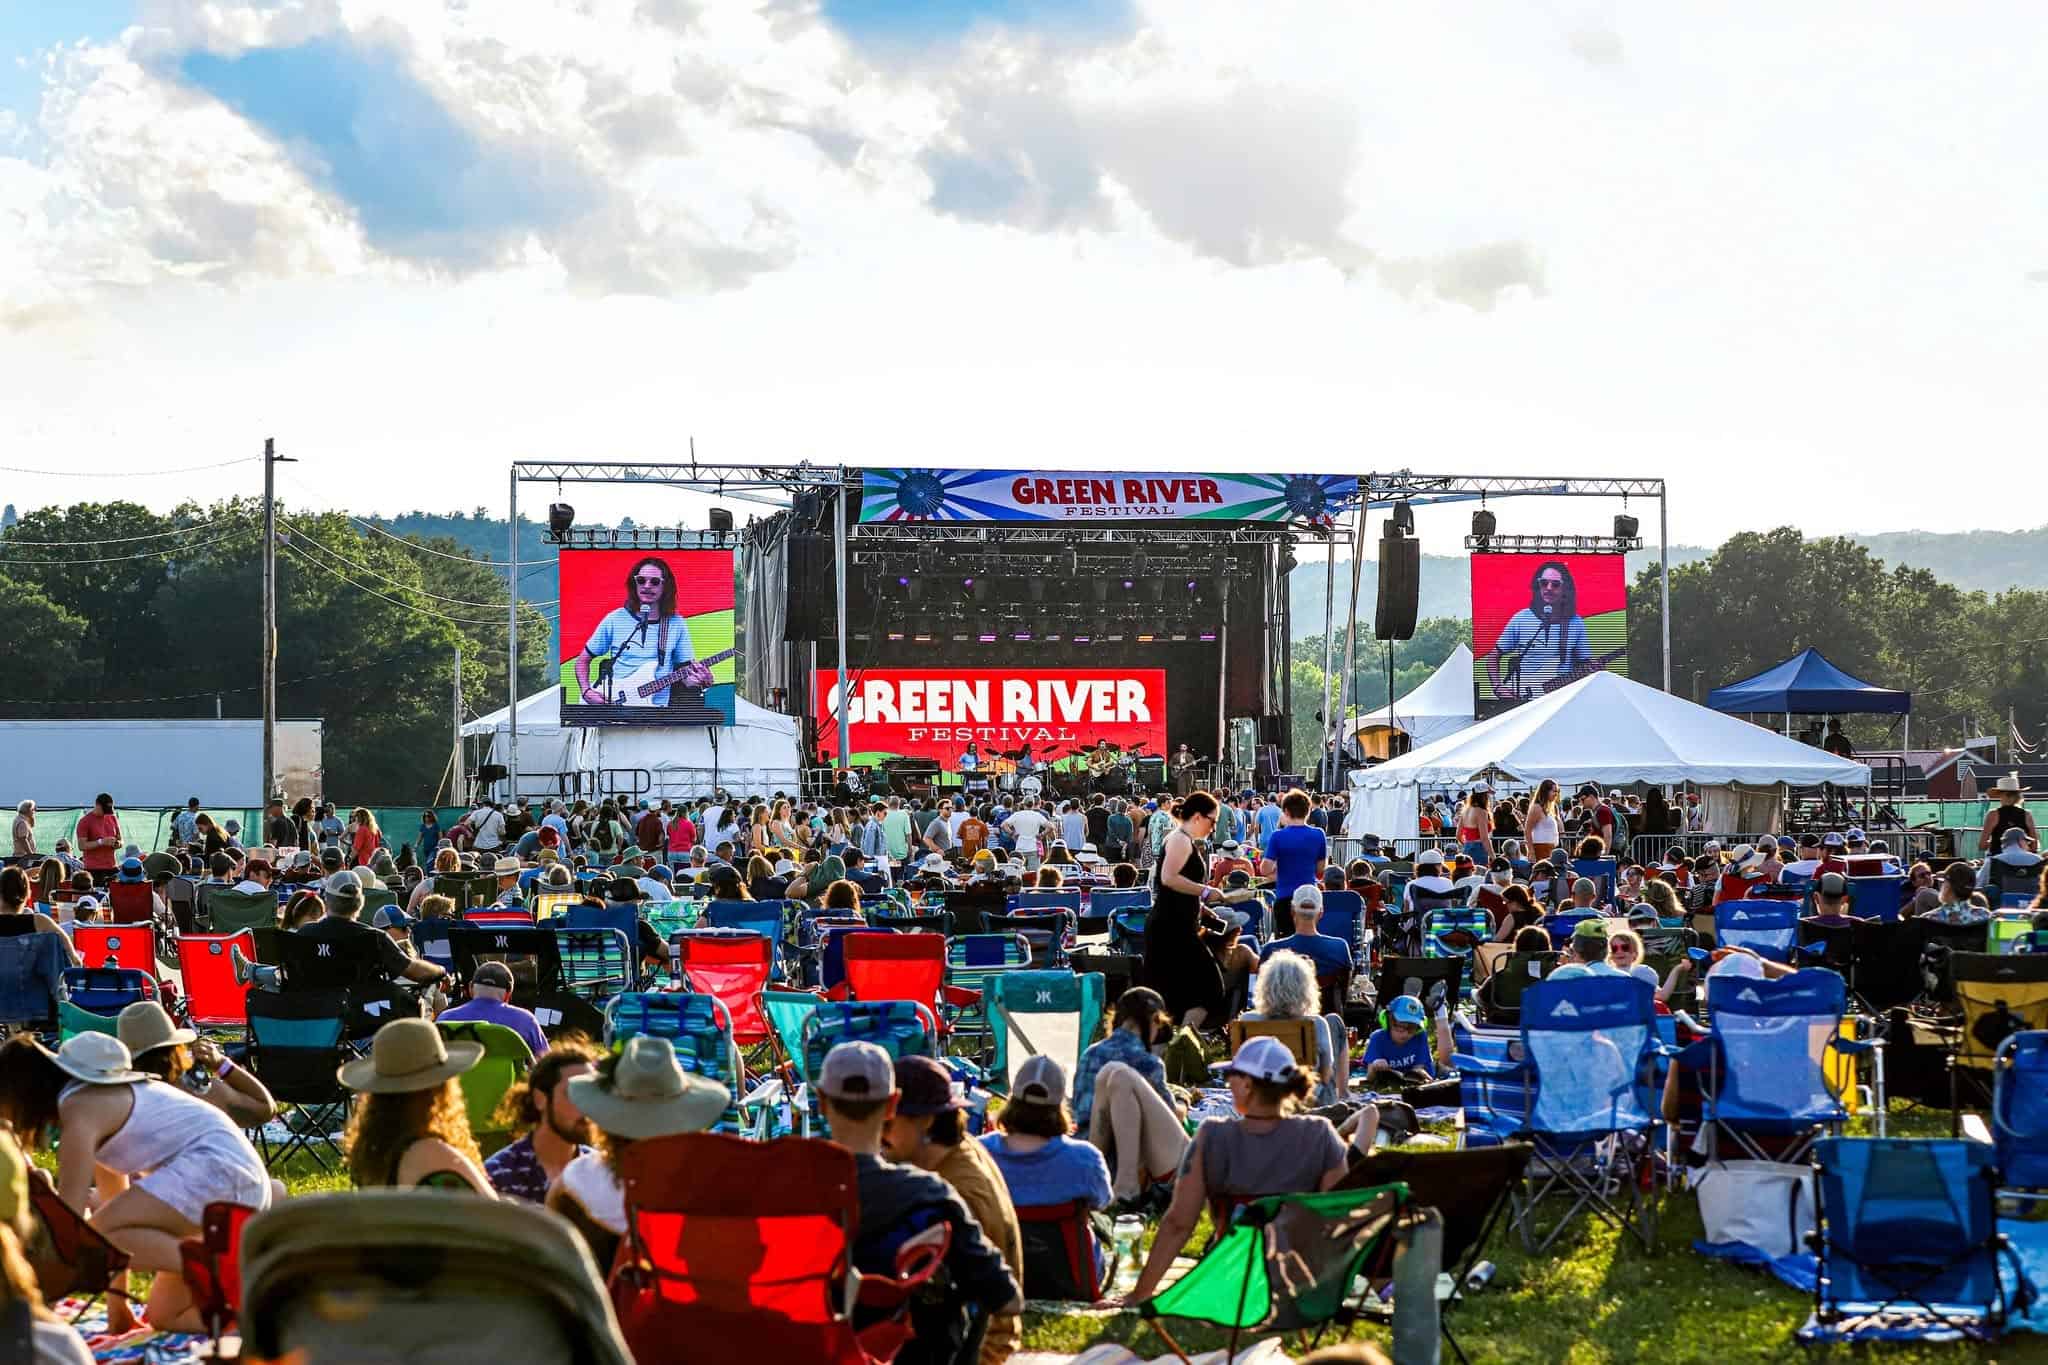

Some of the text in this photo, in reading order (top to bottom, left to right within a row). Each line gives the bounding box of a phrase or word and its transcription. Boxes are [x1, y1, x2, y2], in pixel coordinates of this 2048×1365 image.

[1012, 477, 1223, 504] GREEN RIVER
[1065, 506, 1176, 516] FESTIVAL
[827, 679, 1152, 724] GREEN RIVER
[907, 727, 1077, 742] FESTIVAL
